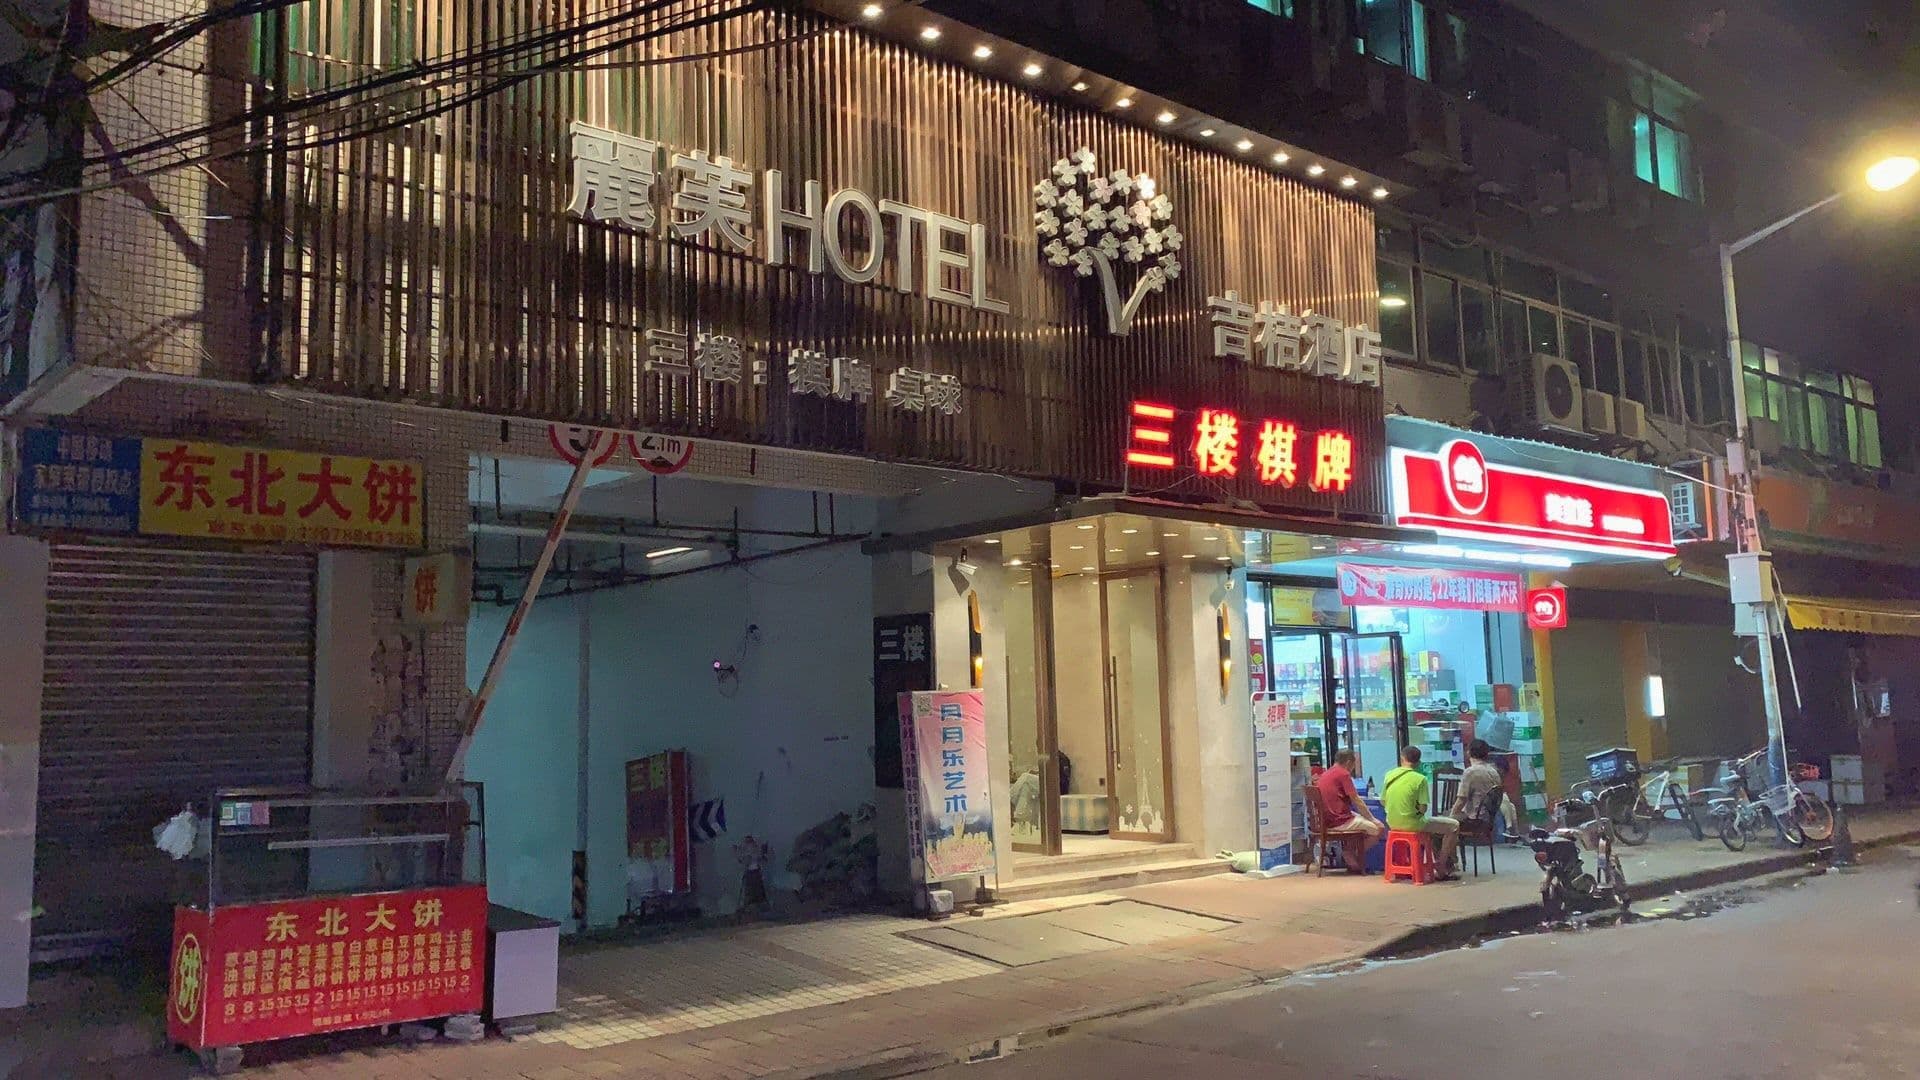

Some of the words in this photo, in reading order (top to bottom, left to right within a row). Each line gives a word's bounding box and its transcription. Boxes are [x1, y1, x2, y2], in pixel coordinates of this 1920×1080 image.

[566, 120, 755, 251] 麗芙
[764, 168, 1010, 314] HOTEL
[787, 347, 873, 404] 棋牌
[884, 366, 964, 416] 桌球
[1126, 402, 1354, 492] 三楼棋牌
[153, 444, 418, 526] 东北大饼
[414, 567, 438, 613] 饼
[879, 624, 925, 662] 三楼
[1267, 703, 1287, 725] 招聘
[265, 899, 444, 941] 东北大饼
[225, 1003, 236, 1016] 8
[243, 1001, 254, 1014] 8
[313, 992, 325, 1004] 2
[460, 974, 470, 986] 2
